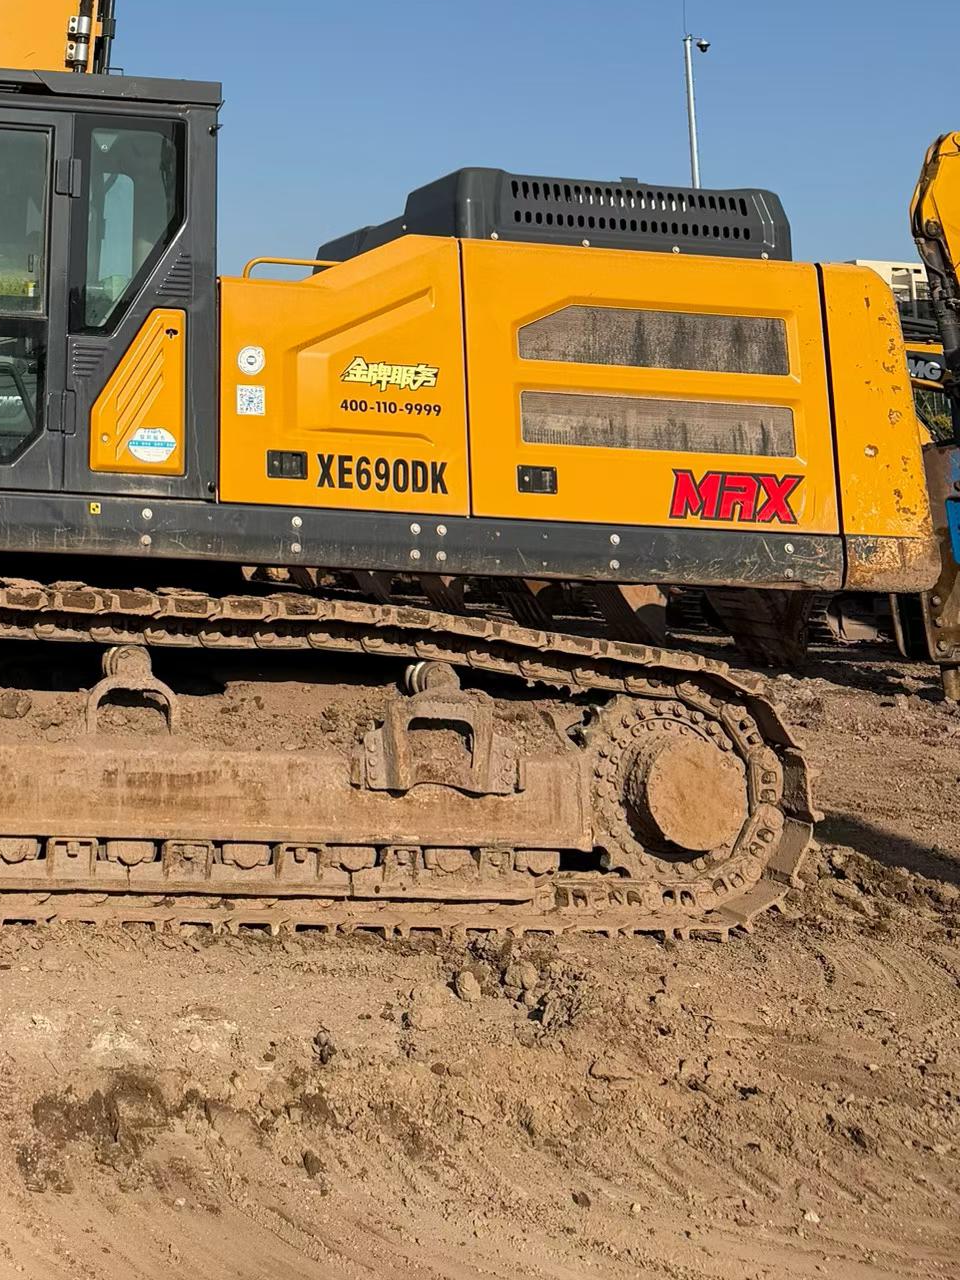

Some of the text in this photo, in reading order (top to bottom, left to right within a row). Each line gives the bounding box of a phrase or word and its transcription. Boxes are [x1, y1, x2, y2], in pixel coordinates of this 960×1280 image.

[340, 356, 440, 391] 金牌服务
[908, 358, 941, 380] MG
[340, 399, 442, 416] 400-110-9999
[316, 453, 449, 495] XE690DK
[669, 469, 806, 525] MAX
